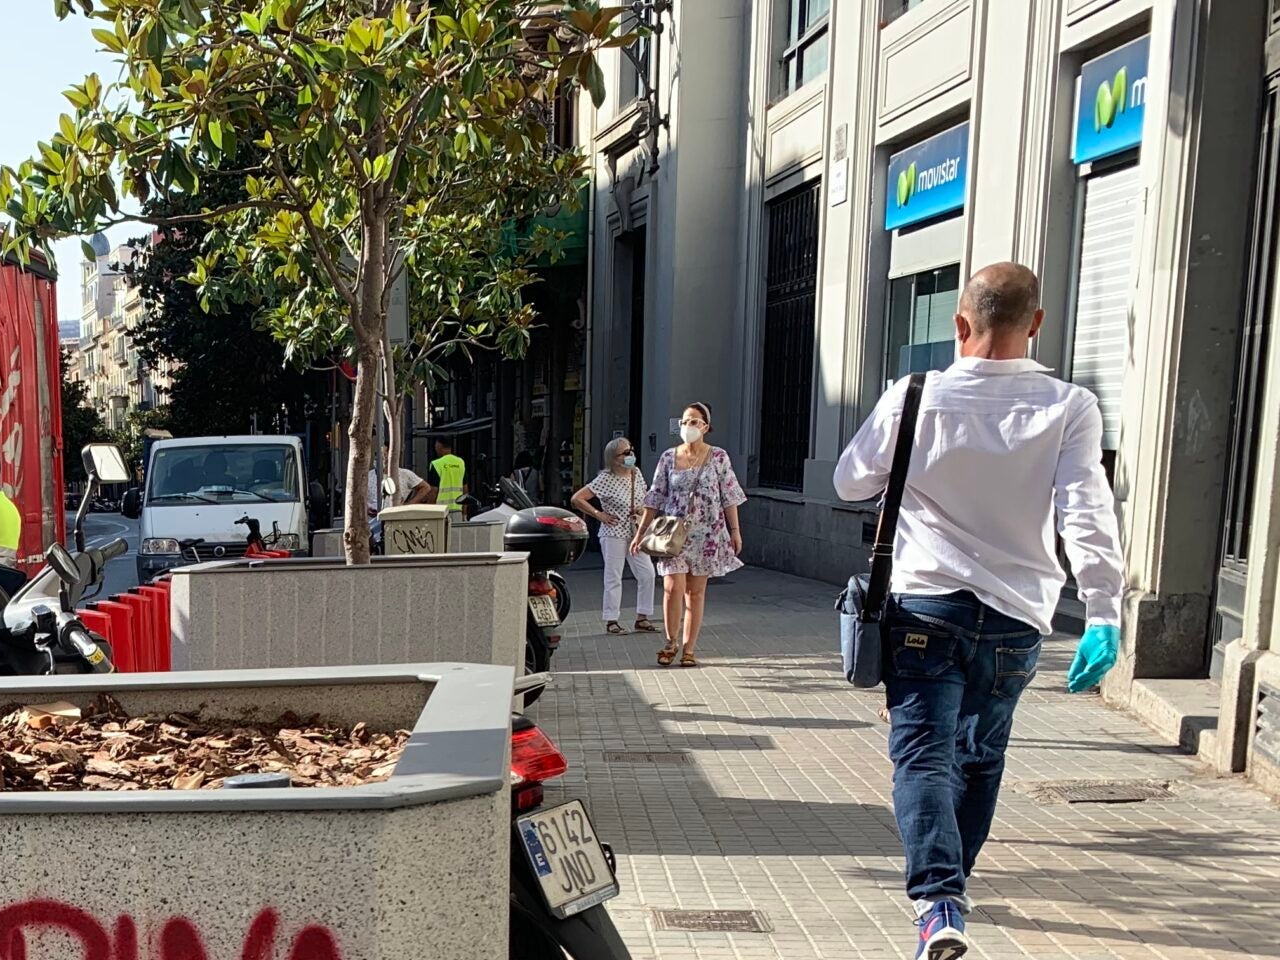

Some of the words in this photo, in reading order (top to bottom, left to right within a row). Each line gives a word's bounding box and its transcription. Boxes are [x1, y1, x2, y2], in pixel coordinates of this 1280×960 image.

[918, 157, 960, 192] movistar
[538, 809, 592, 855] 6142
[560, 850, 595, 893] JND
